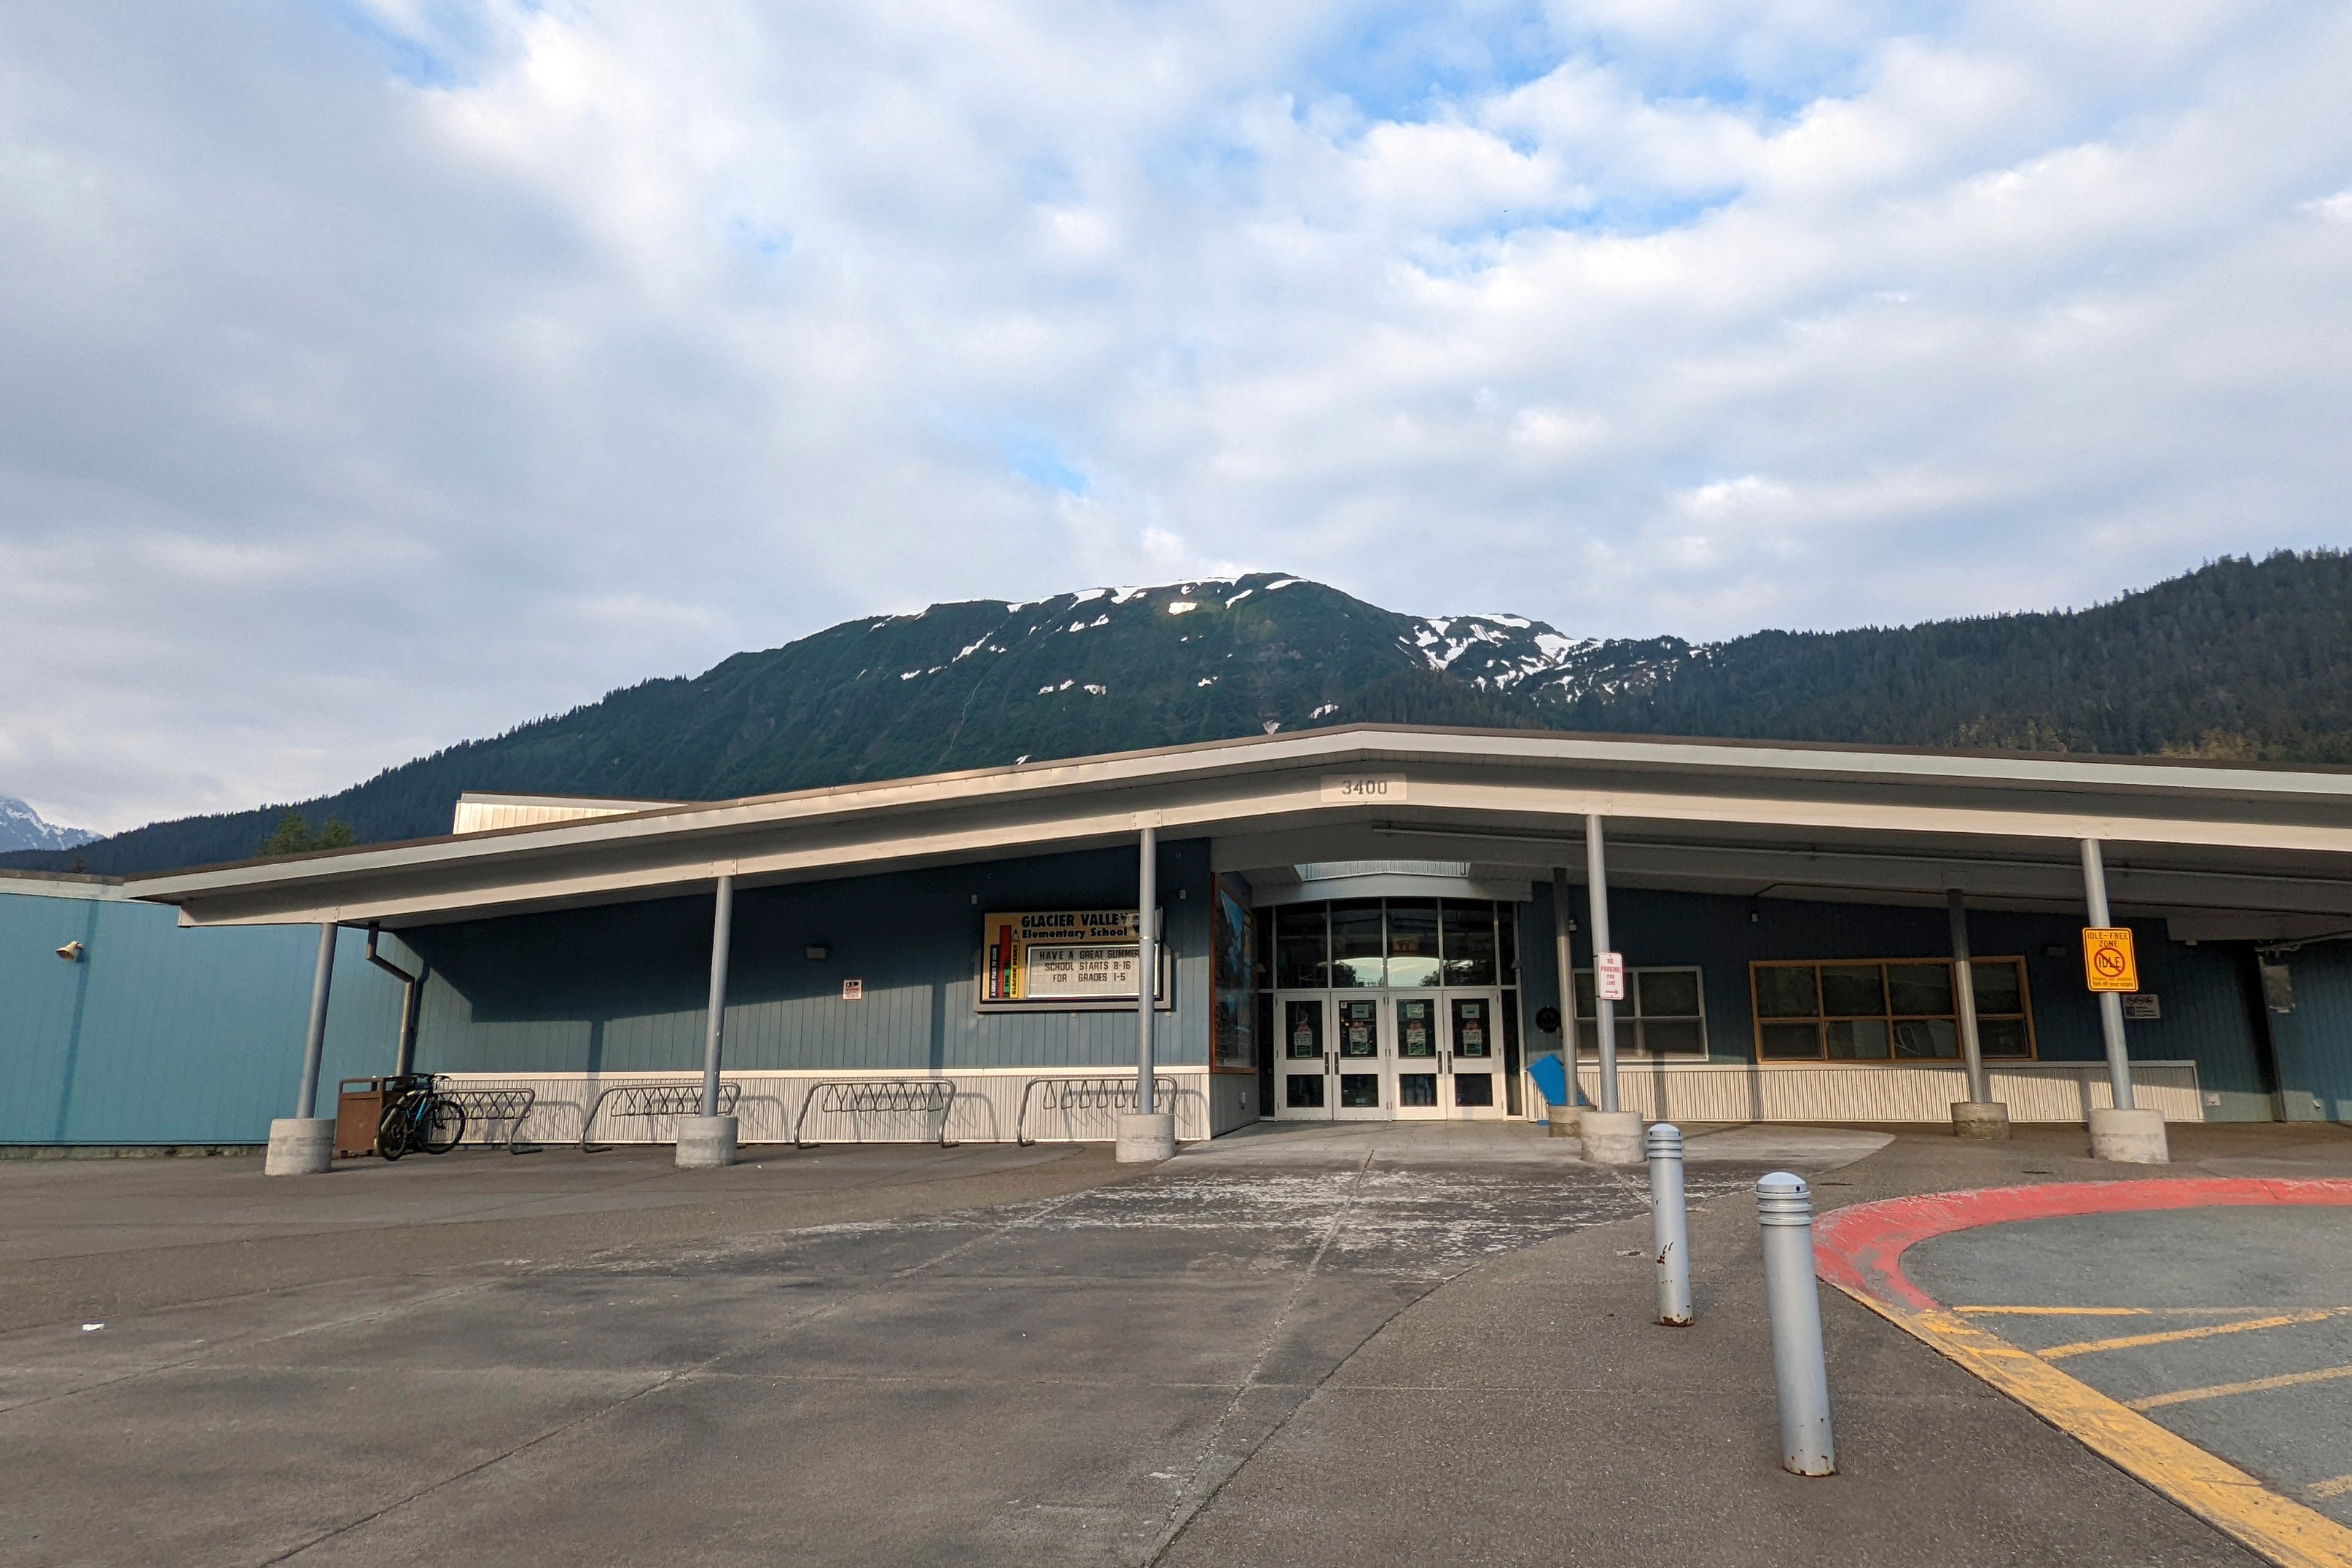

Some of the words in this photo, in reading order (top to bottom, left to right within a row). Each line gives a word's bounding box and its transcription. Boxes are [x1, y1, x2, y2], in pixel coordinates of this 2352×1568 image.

[1342, 780, 1387, 795] 3400
[1021, 914, 1075, 928] GLACIER
[1022, 929, 1086, 939] Elementary
[1090, 927, 1128, 937] School
[2087, 932, 2128, 940] IDLE-FREE
[1039, 950, 1063, 960] HAVE
[1068, 950, 1074, 960] A
[1079, 950, 1103, 960] GREAT
[1107, 949, 1140, 959] SUMMER
[1044, 962, 1074, 971] SCHOOL
[1079, 961, 1109, 971] STARTS
[1114, 961, 1130, 970] 8-16
[2098, 956, 2121, 968] IDLE
[1052, 973, 1067, 982] FOR
[1078, 973, 1108, 982] GRADES
[1113, 973, 1126, 981] 1-5
